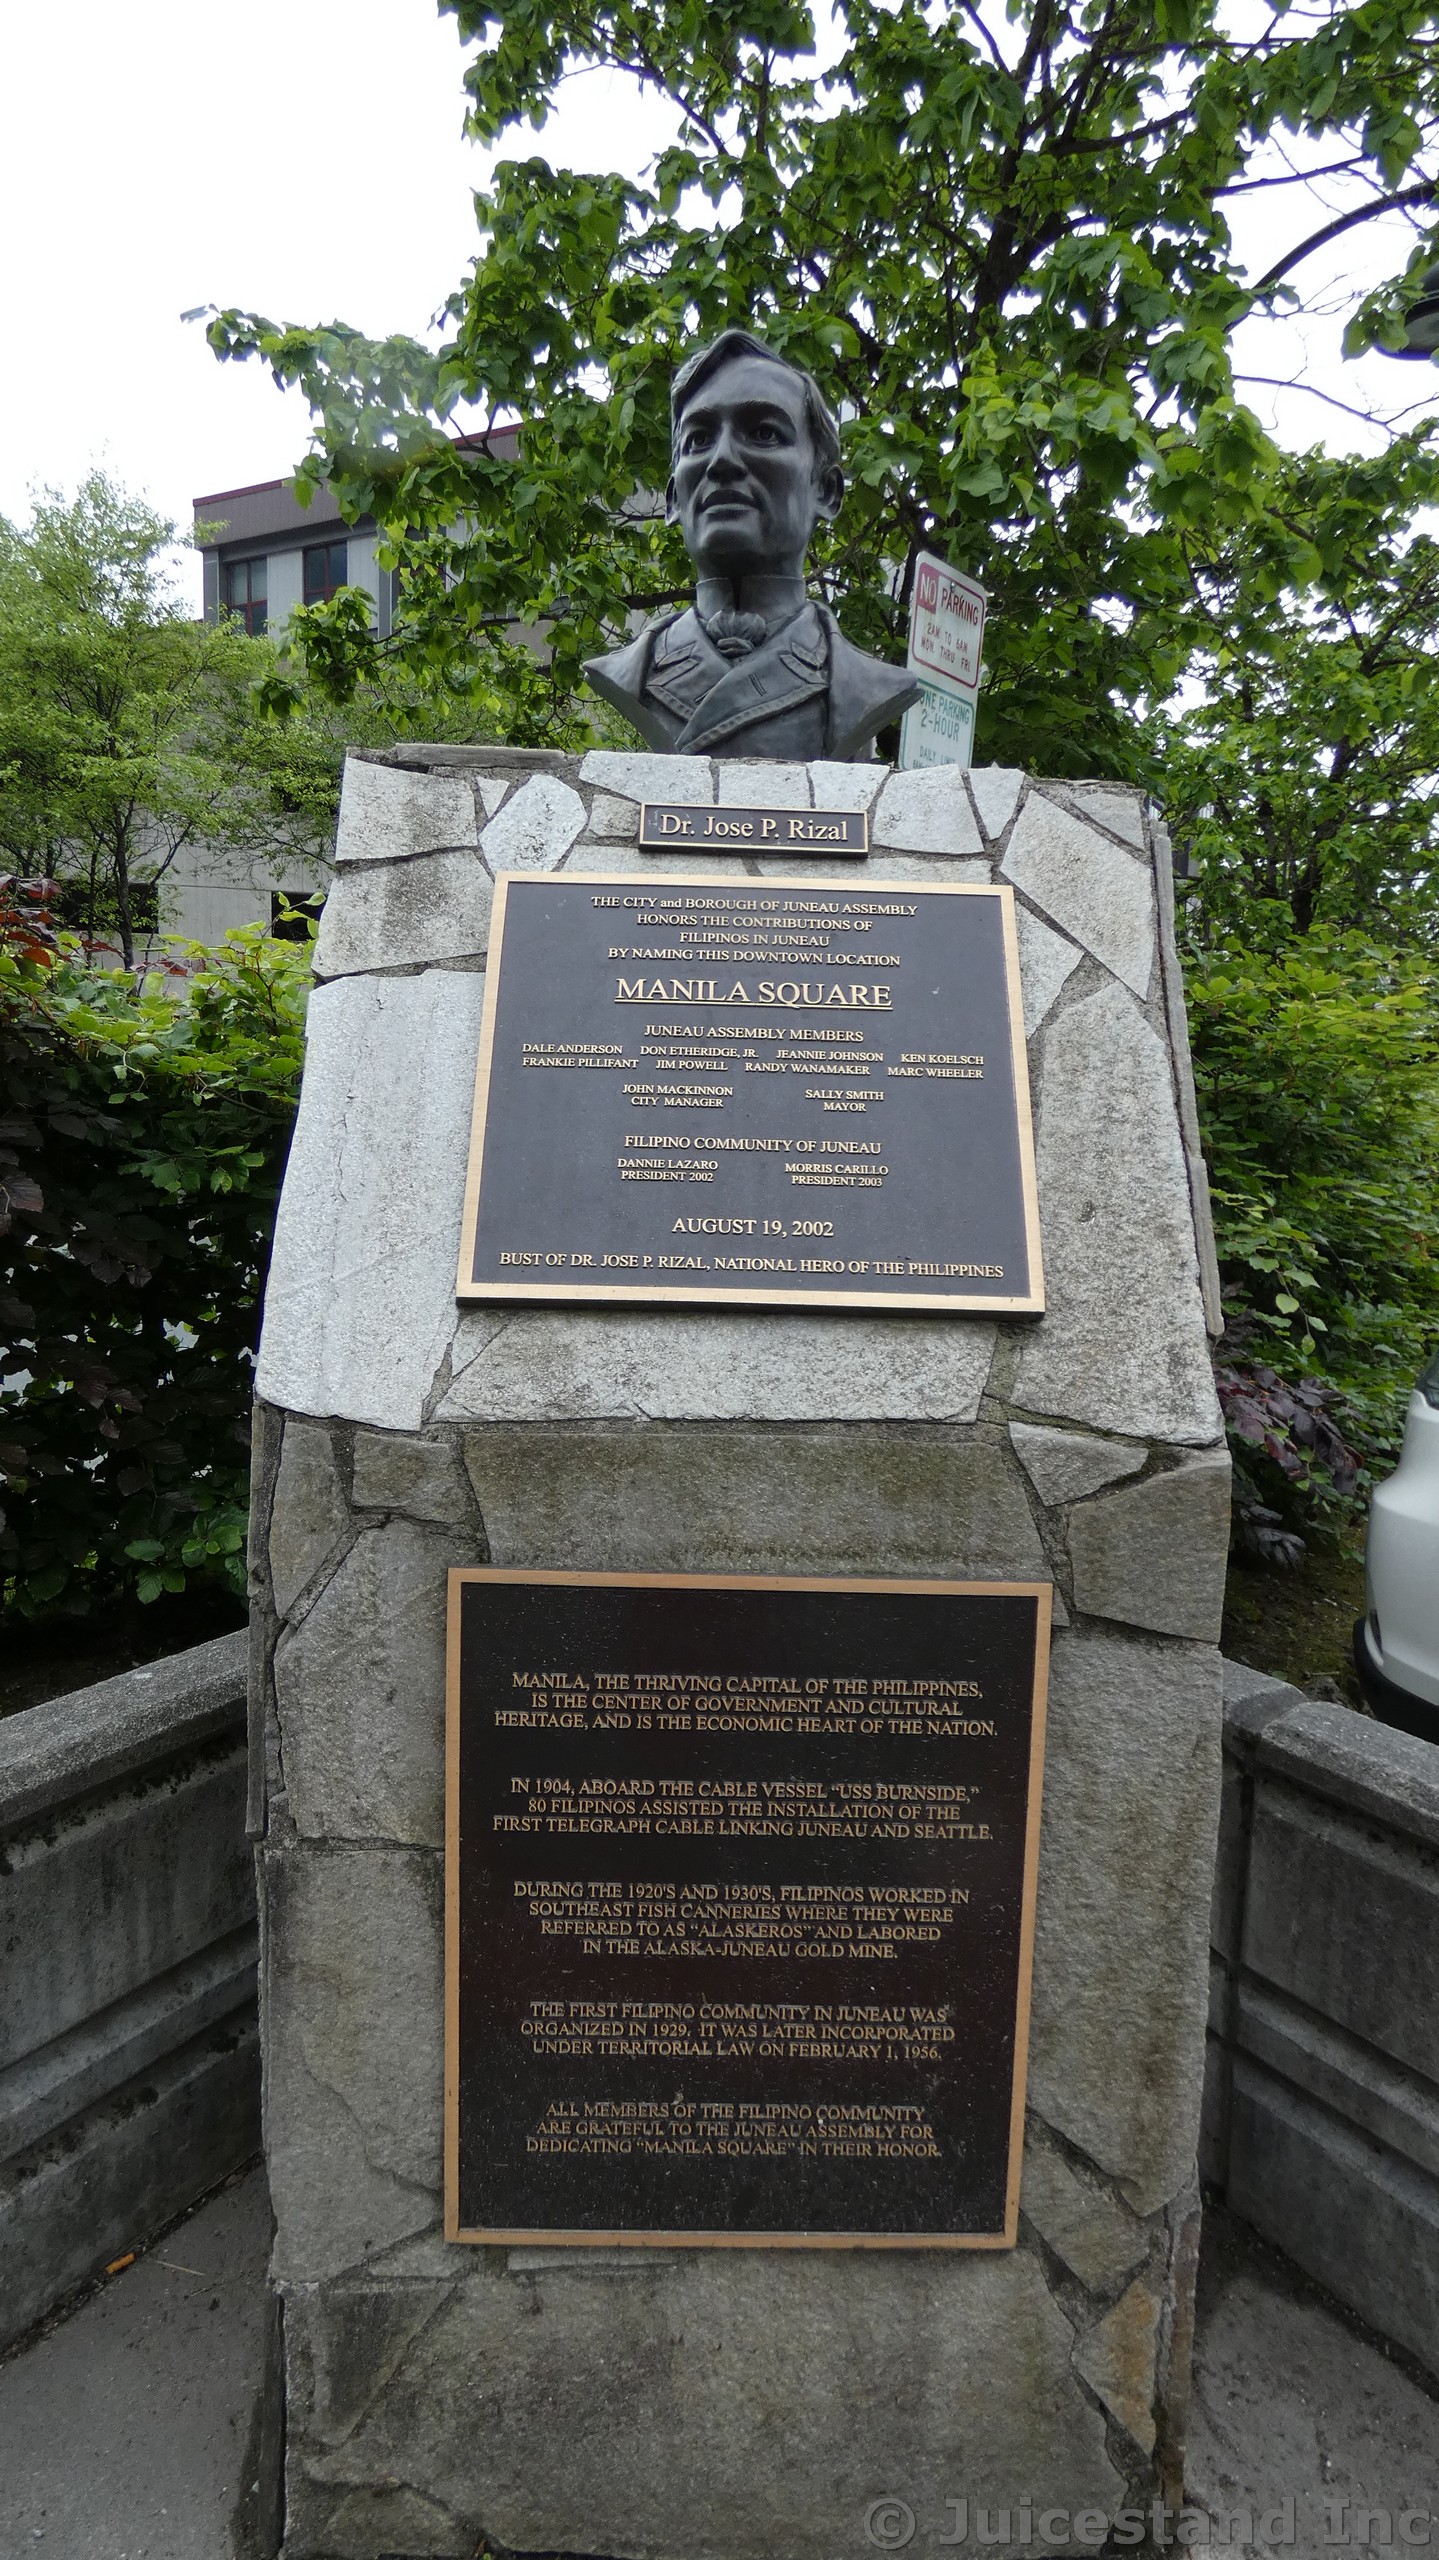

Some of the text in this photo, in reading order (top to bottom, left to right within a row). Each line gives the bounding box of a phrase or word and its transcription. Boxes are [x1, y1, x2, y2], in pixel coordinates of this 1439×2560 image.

[920, 573, 979, 626] NO PARKING
[945, 631, 952, 646] TO
[940, 646, 955, 664] THRU
[938, 696, 970, 725] PARKING
[920, 708, 960, 742] 2-HOUR
[659, 814, 848, 840] Dr. Jose P. Rizal
[590, 896, 917, 915] THE CITY and BOROUGH OF JUNEAU ASSEMBLY
[637, 913, 872, 930] HONORS THE CONTRIBUTIONS OF
[679, 931, 829, 946] FILIPINOS IN JUNEAU
[607, 947, 900, 965] BY NAMING THIS DOWNTOWN LOCATION
[614, 977, 893, 1008] MANILA SQUARE
[643, 1024, 863, 1041] JUNEAU ASSEMBLY MEMBERS
[521, 1043, 623, 1053] DALE ANDERSON
[639, 1045, 759, 1058] DON ETHERIDGE, JR.
[775, 1049, 883, 1061] JEANNIE JOHNSON
[521, 1056, 639, 1067] FRANKIE PILLIFANT
[655, 1059, 728, 1070] JIM POWELL
[900, 1053, 983, 1064] KEN KOELSCH
[744, 1062, 870, 1074] RANDY WANAMAKER
[887, 1066, 983, 1078] MARC WHEELER
[621, 1083, 733, 1095] JOHN MACKINNON
[804, 1088, 884, 1100] SALLY SMITH
[630, 1096, 723, 1106] CITY MANAGER
[823, 1101, 867, 1111] MAYOR
[624, 1135, 881, 1153] FILIPINO COMMUNITY OF JUNEAU
[617, 1157, 718, 1169] DANNIE LAZARO
[784, 1162, 888, 1174] MORRIS CARILLO
[620, 1170, 713, 1181] PRESIDENT 2002
[791, 1174, 882, 1186] PRESIDENT 2003
[671, 1217, 834, 1237] AUGUST 19, 2002
[498, 1252, 1003, 1277] BUST OF DR. JOSE P. RIZAL, NATIONAL HERO OF THE PHILIPPINES
[512, 1672, 983, 1698] MANILA, THE THRIVING CAPITAL OF THE PHILIPPINES,
[510, 1777, 530, 1793] IN
[535, 1777, 574, 1796] 1904,
[578, 1778, 654, 1795] ABOARD
[658, 1780, 693, 1796] THE
[698, 1780, 757, 1797] CABLE
[761, 1781, 827, 1798] VESSEL
[513, 1880, 583, 1897] DURING
[587, 1881, 622, 1898] THE
[679, 1883, 718, 1899] AND
[779, 1884, 864, 1902] FILIPINOS
[869, 1887, 947, 1904] WORKED
[951, 1888, 970, 1904] IN
[540, 1918, 632, 1935] REFERRED
[635, 1920, 659, 1936] TO
[662, 1921, 685, 1936] AS
[812, 1925, 852, 1939] AND
[856, 1925, 941, 1940] LABORED
[582, 1938, 897, 1958] IN THE ALASKA-JUNEAU GOLD MINE.
[529, 2001, 949, 2022] THE FIRST FILIPINO COMMUNITY IN JUNEAU WAS
[545, 2101, 925, 2121] ALL MEMBERS OF THE FILIPINO COMMUNITY
[525, 2137, 631, 2153] DEDICATING
[797, 2140, 817, 2155] IN
[821, 2141, 872, 2156] THEIR
[874, 2141, 942, 2156] HONOR.
